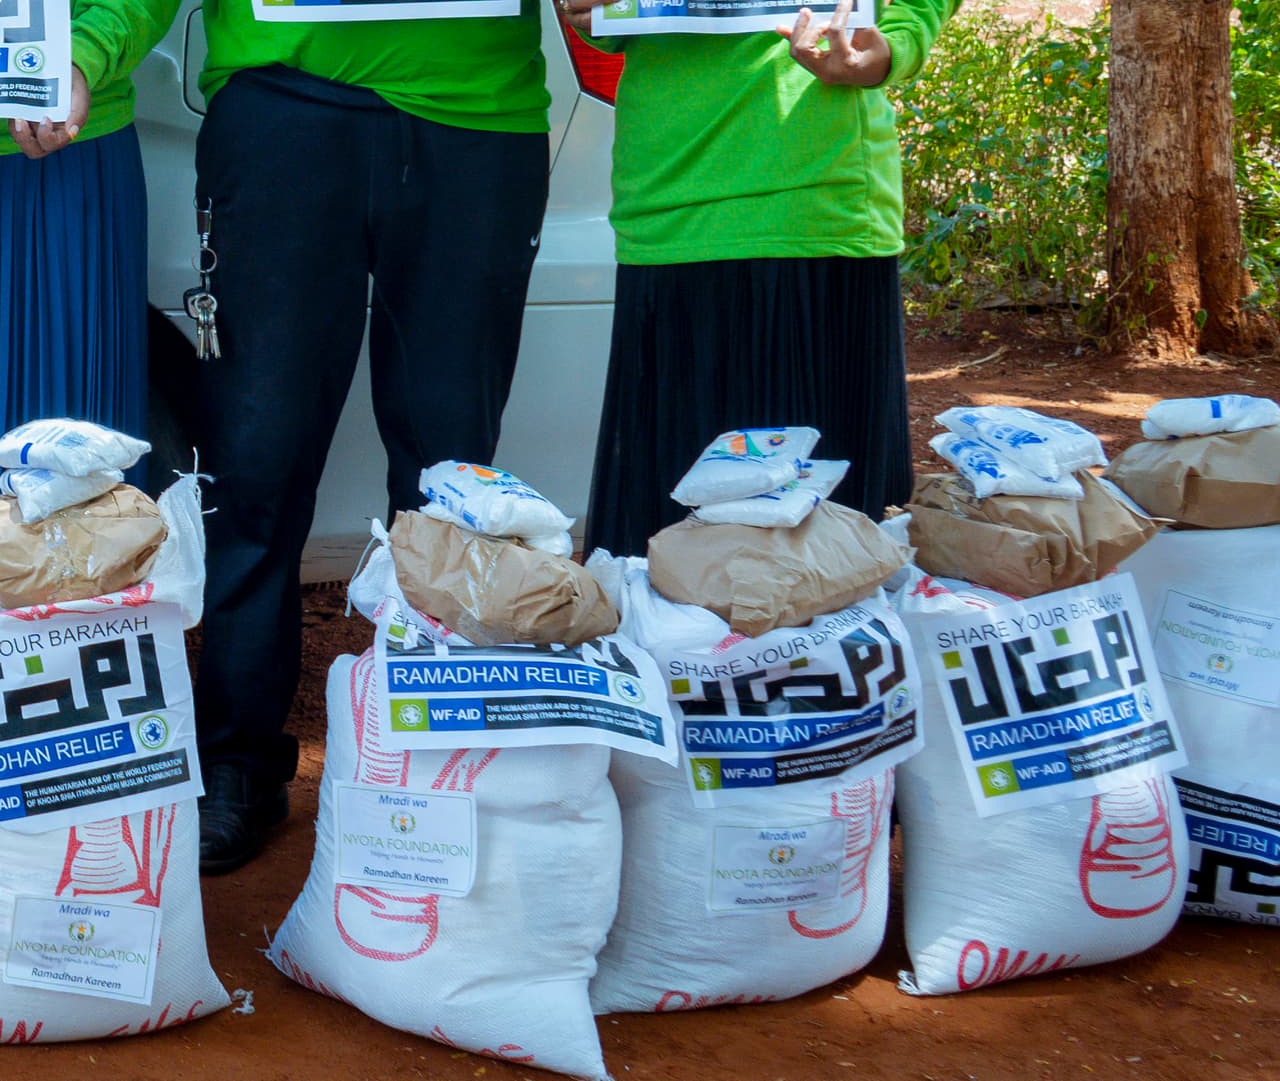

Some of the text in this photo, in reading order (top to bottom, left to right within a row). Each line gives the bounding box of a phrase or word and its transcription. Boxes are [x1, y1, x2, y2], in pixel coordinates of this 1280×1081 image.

[48, 616, 148, 647] BARAKAH
[936, 592, 1123, 650] SHARE YOUR BARAKAH
[670, 638, 810, 678] SHARE YOUR
[392, 666, 600, 686] RAMADHAN RELIEF
[430, 708, 481, 722] WF-AID
[972, 716, 1090, 752] RAMADHAN
[1092, 698, 1135, 728] RELIEF
[56, 730, 124, 758] RELIEF
[686, 726, 810, 744] RAMADHAN
[722, 766, 772, 780] WF-AID
[1016, 761, 1066, 780] WF-AID
[1190, 824, 1268, 852] RELIEF
[957, 939, 1080, 990] OMAN
